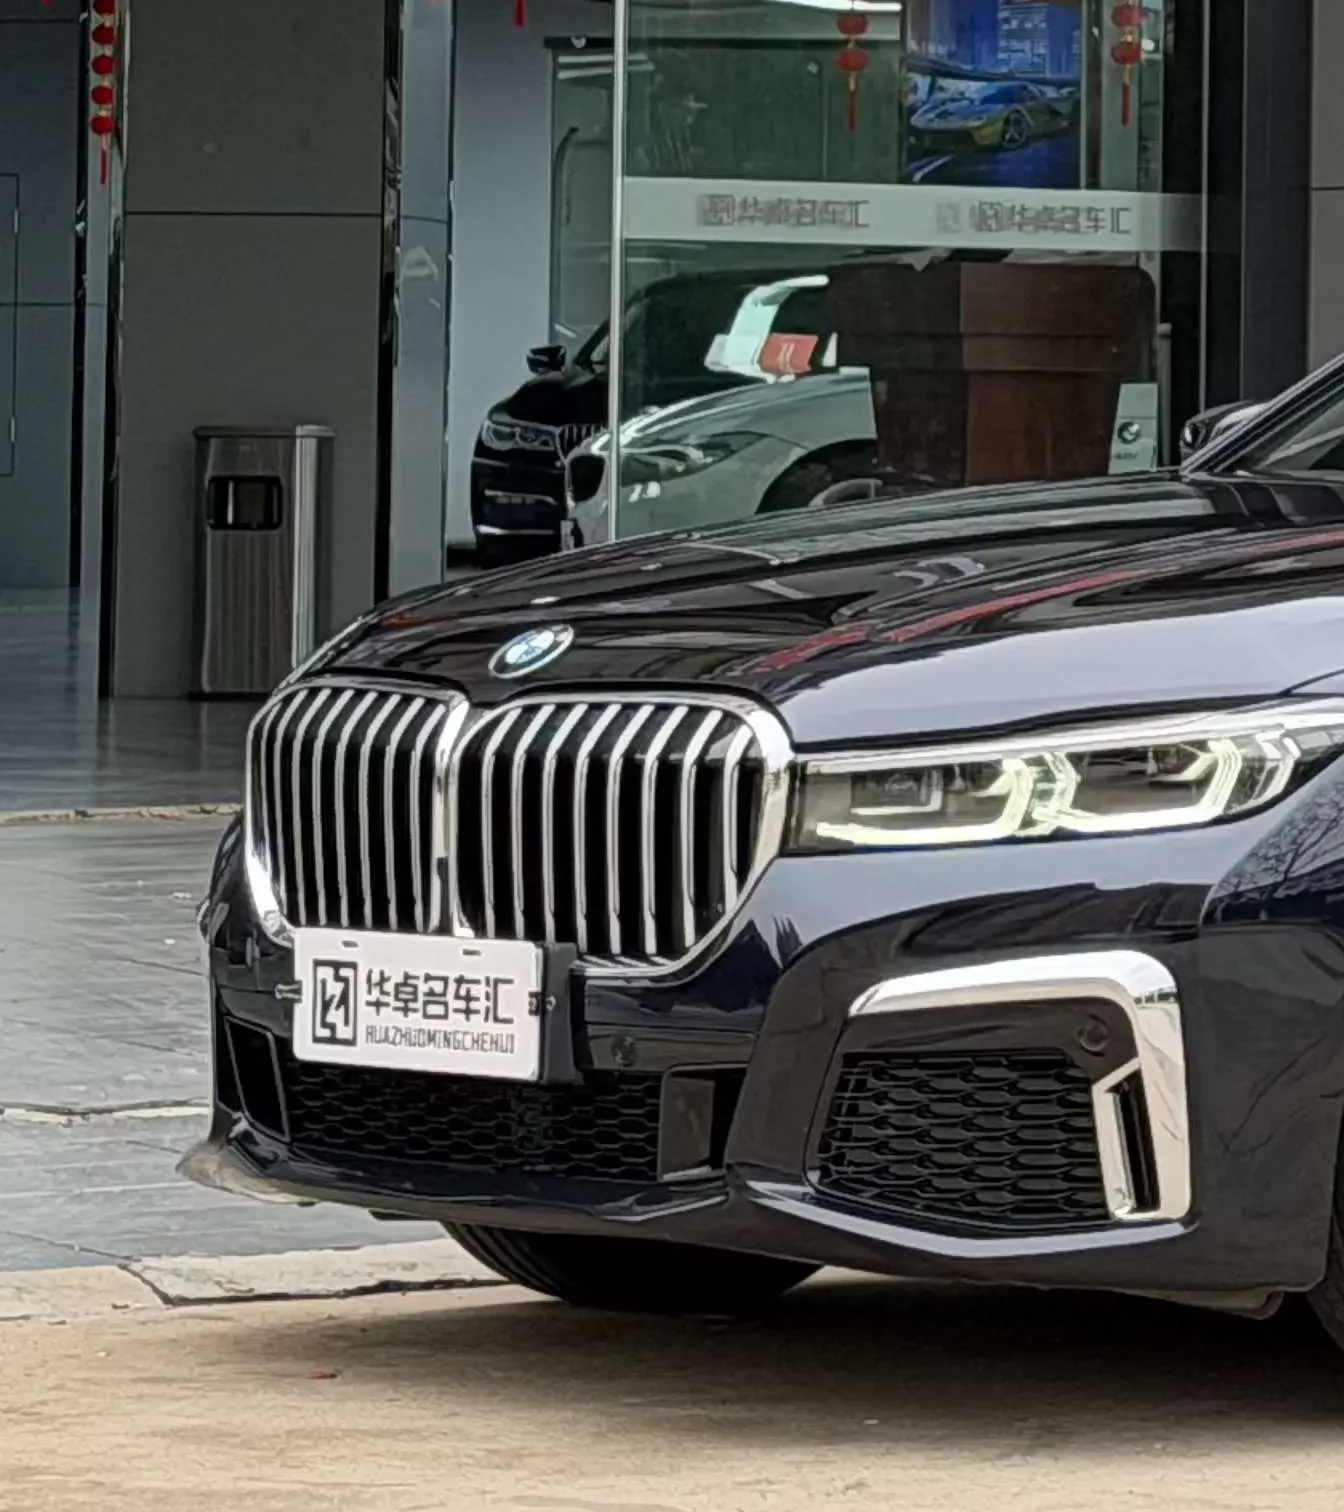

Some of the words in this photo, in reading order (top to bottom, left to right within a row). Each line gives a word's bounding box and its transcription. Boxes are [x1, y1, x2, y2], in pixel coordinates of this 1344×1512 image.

[365, 968, 515, 1025] 华卓名车汇
